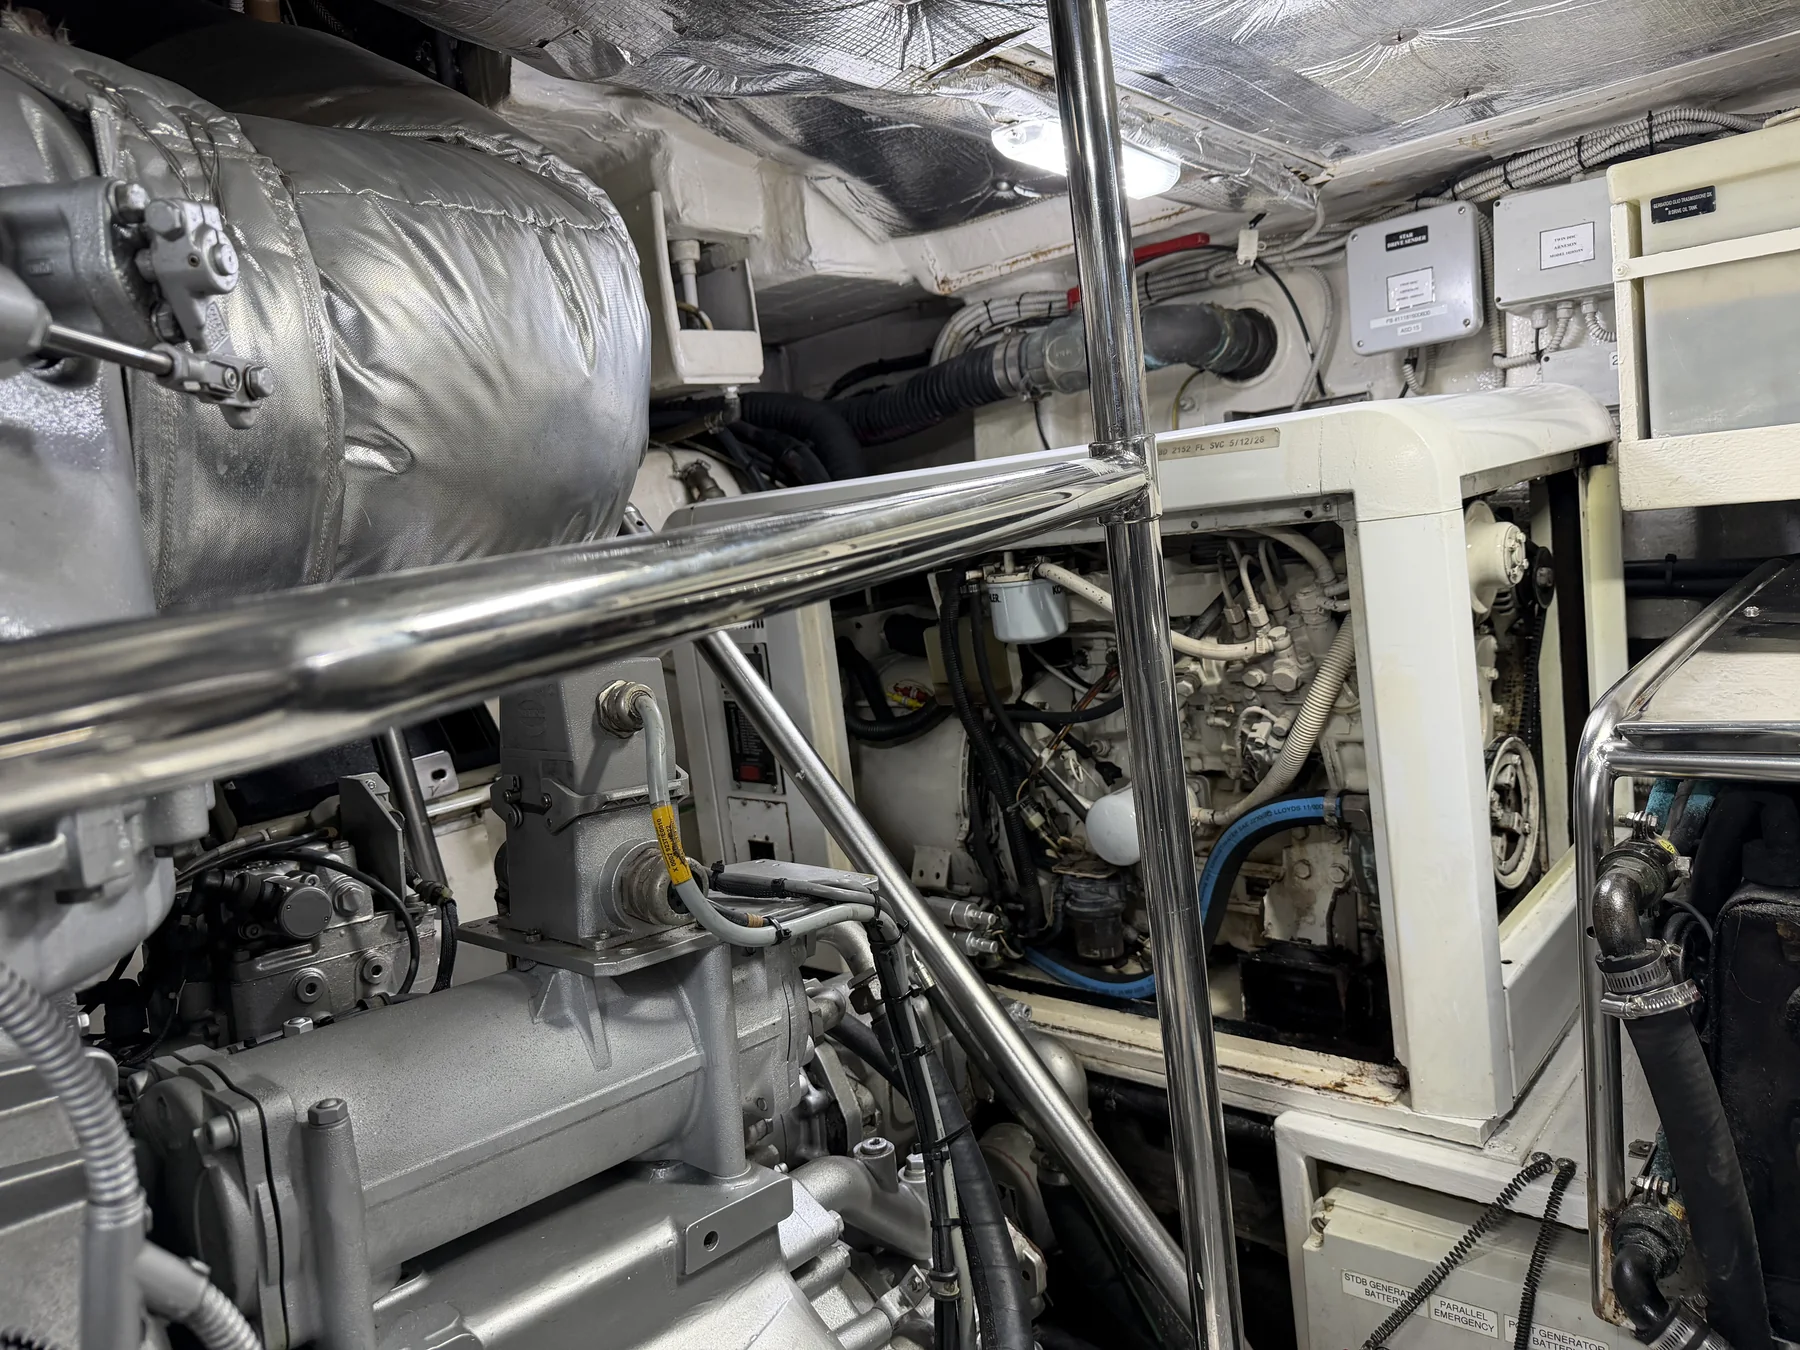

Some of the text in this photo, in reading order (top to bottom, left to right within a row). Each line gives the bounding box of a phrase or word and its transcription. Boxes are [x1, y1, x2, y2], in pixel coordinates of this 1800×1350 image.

[1171, 446, 1191, 455] 2152
[1195, 443, 1205, 452] FL
[1209, 441, 1225, 450] SVC
[1273, 805, 1301, 815] LLOYDS
[1344, 1272, 1412, 1298] STDB GENERAT
[1434, 1308, 1495, 1333] EMERGENCY
[1440, 1300, 1488, 1322] PARALLEL
